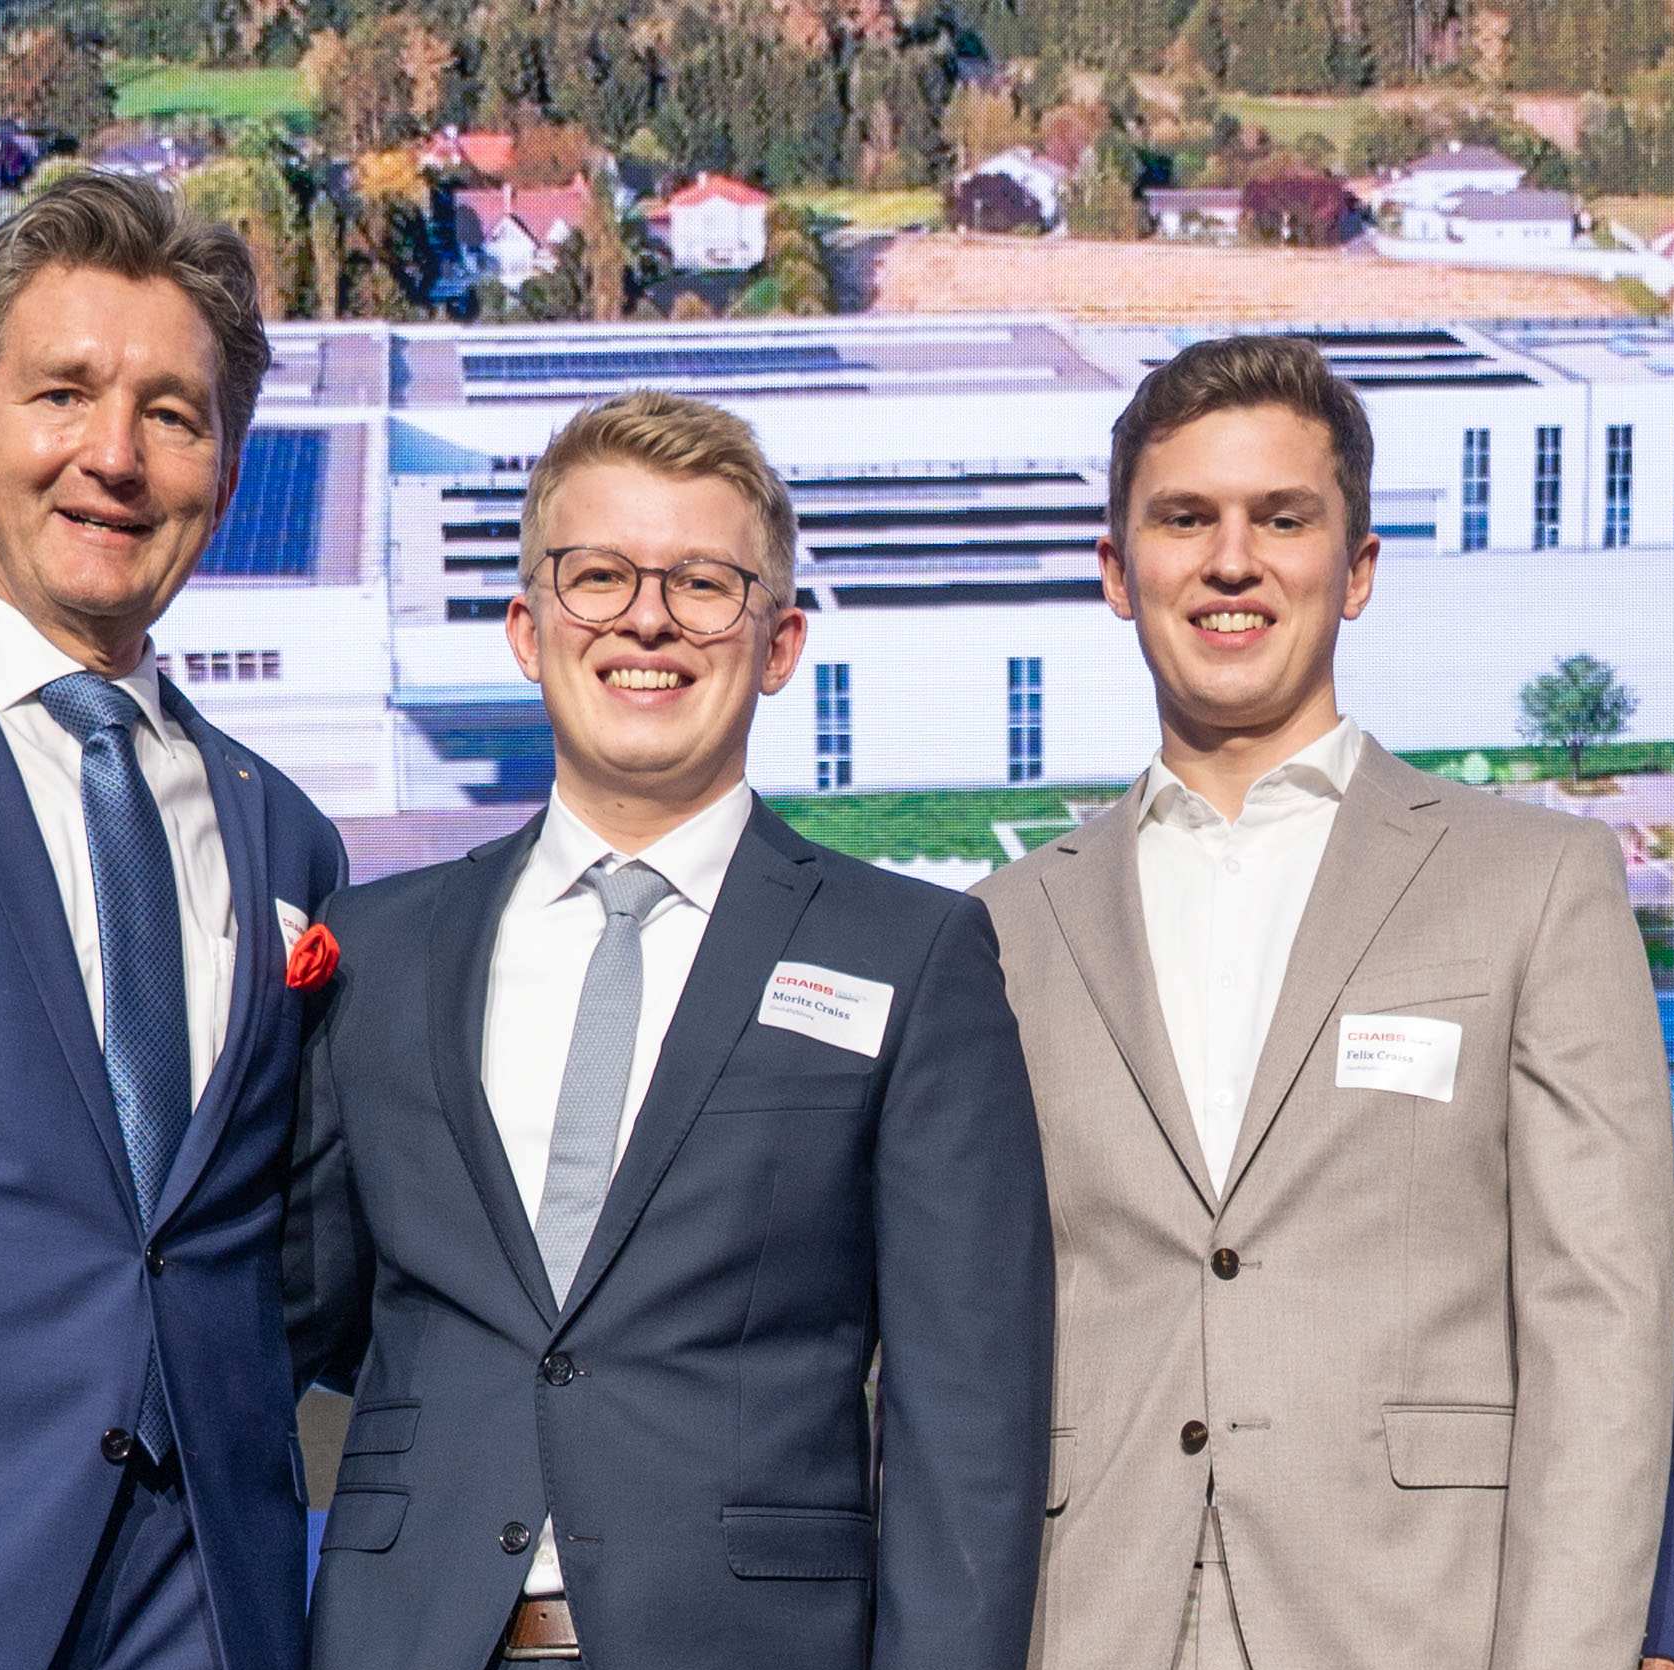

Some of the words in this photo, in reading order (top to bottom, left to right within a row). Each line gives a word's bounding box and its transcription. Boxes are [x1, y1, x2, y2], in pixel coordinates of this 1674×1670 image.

[776, 976, 834, 996] CRAISS
[772, 991, 813, 1008] Moritz
[814, 1001, 852, 1020] Craiss
[1346, 1050, 1375, 1060] Felix
